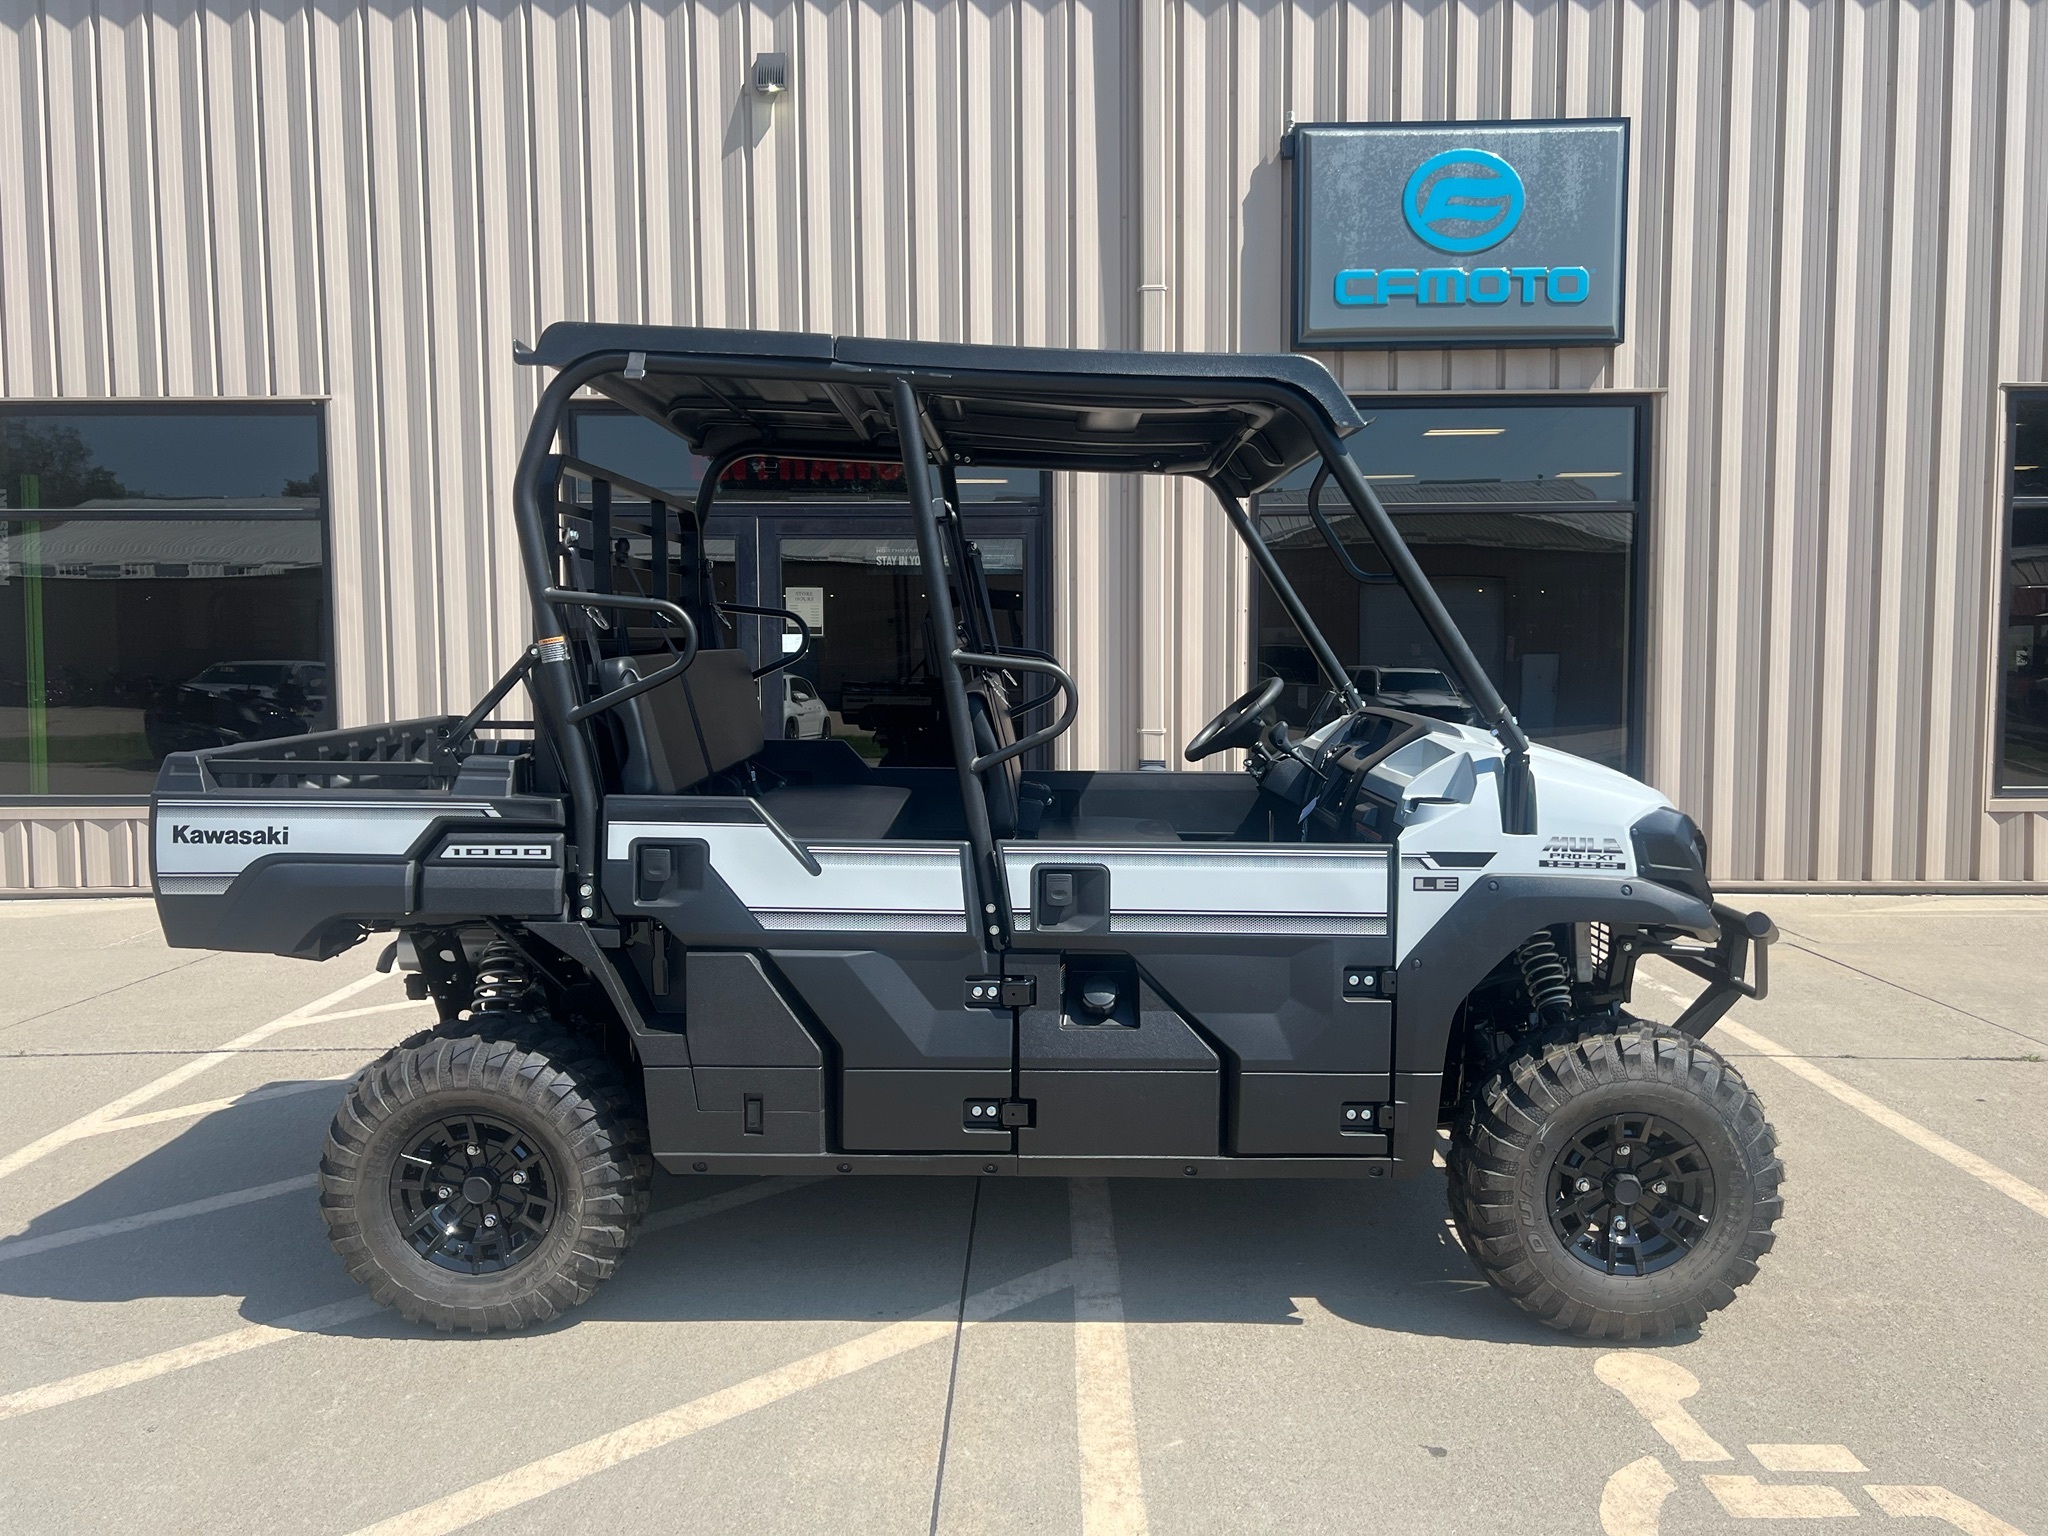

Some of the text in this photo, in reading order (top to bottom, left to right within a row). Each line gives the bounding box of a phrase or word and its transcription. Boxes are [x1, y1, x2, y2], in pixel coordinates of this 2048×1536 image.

[1334, 266, 1590, 305] CFMOTO
[876, 556, 897, 566] STAY
[899, 556, 907, 566] IN
[172, 825, 289, 846] Kawasaki
[449, 847, 549, 858] 1000
[1542, 837, 1623, 854] MULE
[1414, 878, 1458, 891] LE
